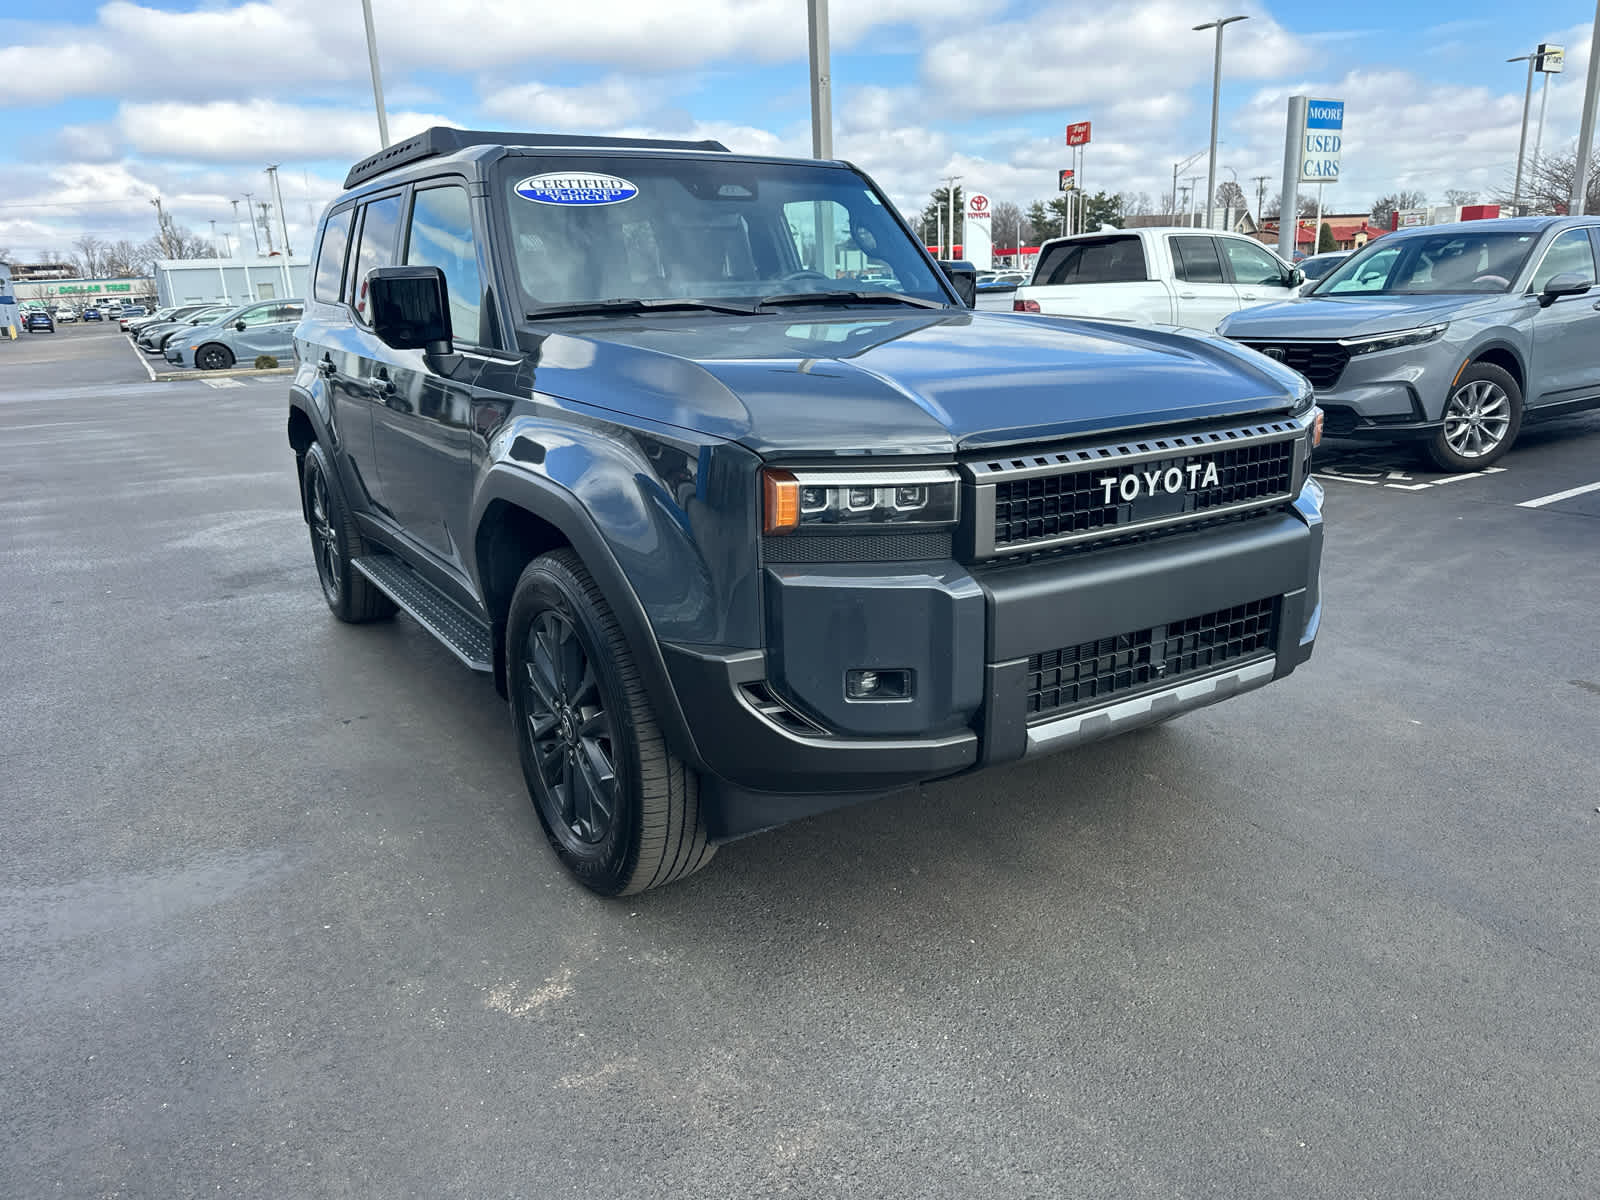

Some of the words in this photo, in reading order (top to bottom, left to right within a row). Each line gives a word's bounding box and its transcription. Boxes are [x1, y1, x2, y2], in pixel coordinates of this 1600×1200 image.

[1310, 107, 1342, 120] MOORE
[1306, 135, 1341, 152] USED
[1303, 160, 1339, 176] CARS
[529, 178, 624, 189] CERTIFIED
[59, 285, 101, 294] DOLLAR
[105, 284, 130, 292] TREE
[1100, 461, 1220, 505] TOYOTA
